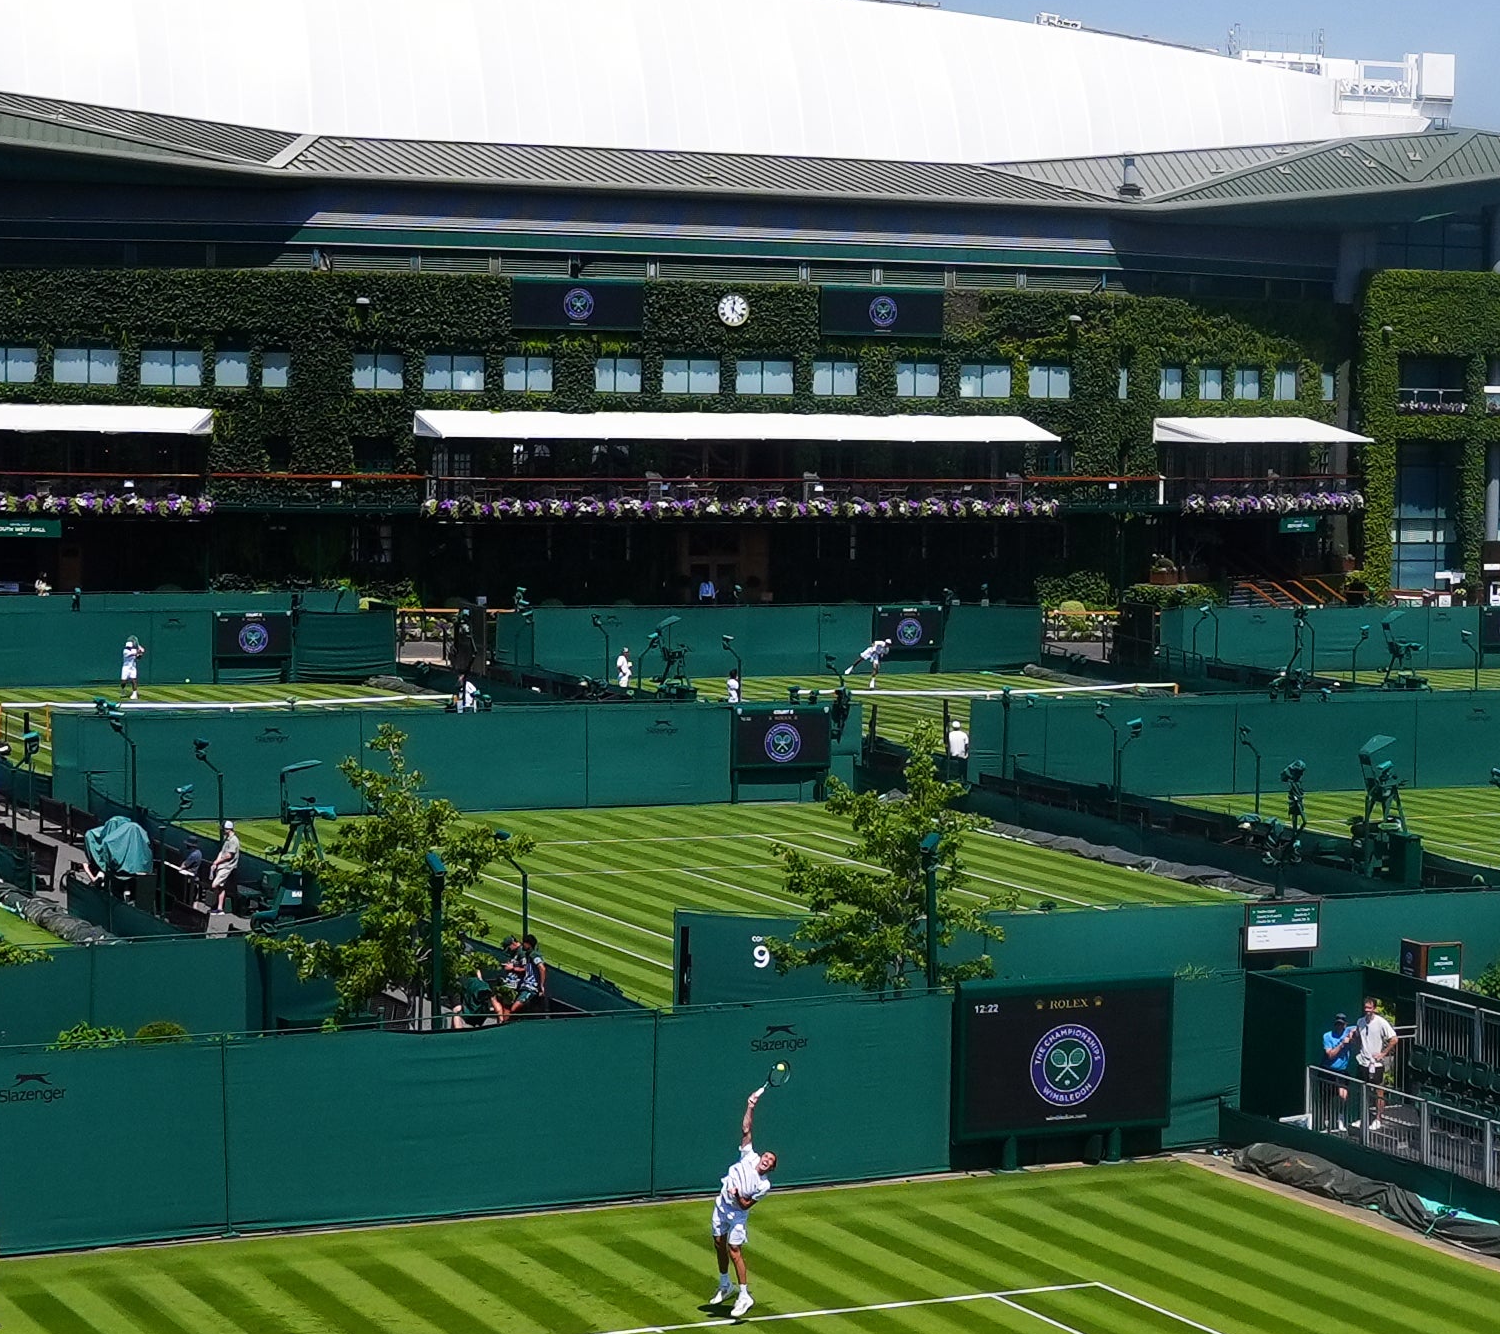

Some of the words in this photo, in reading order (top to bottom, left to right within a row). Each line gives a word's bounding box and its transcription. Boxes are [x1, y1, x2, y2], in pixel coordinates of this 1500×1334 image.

[753, 945, 770, 968] 9
[974, 1003, 999, 1014] 12:22
[1049, 998, 1089, 1010] ROLEX
[751, 1037, 809, 1052] Slazenger
[1034, 1045, 1046, 1065] THE
[1043, 1028, 1101, 1062] CHAMPIONSHIPS
[1041, 1082, 1093, 1102] WIMBLEDON
